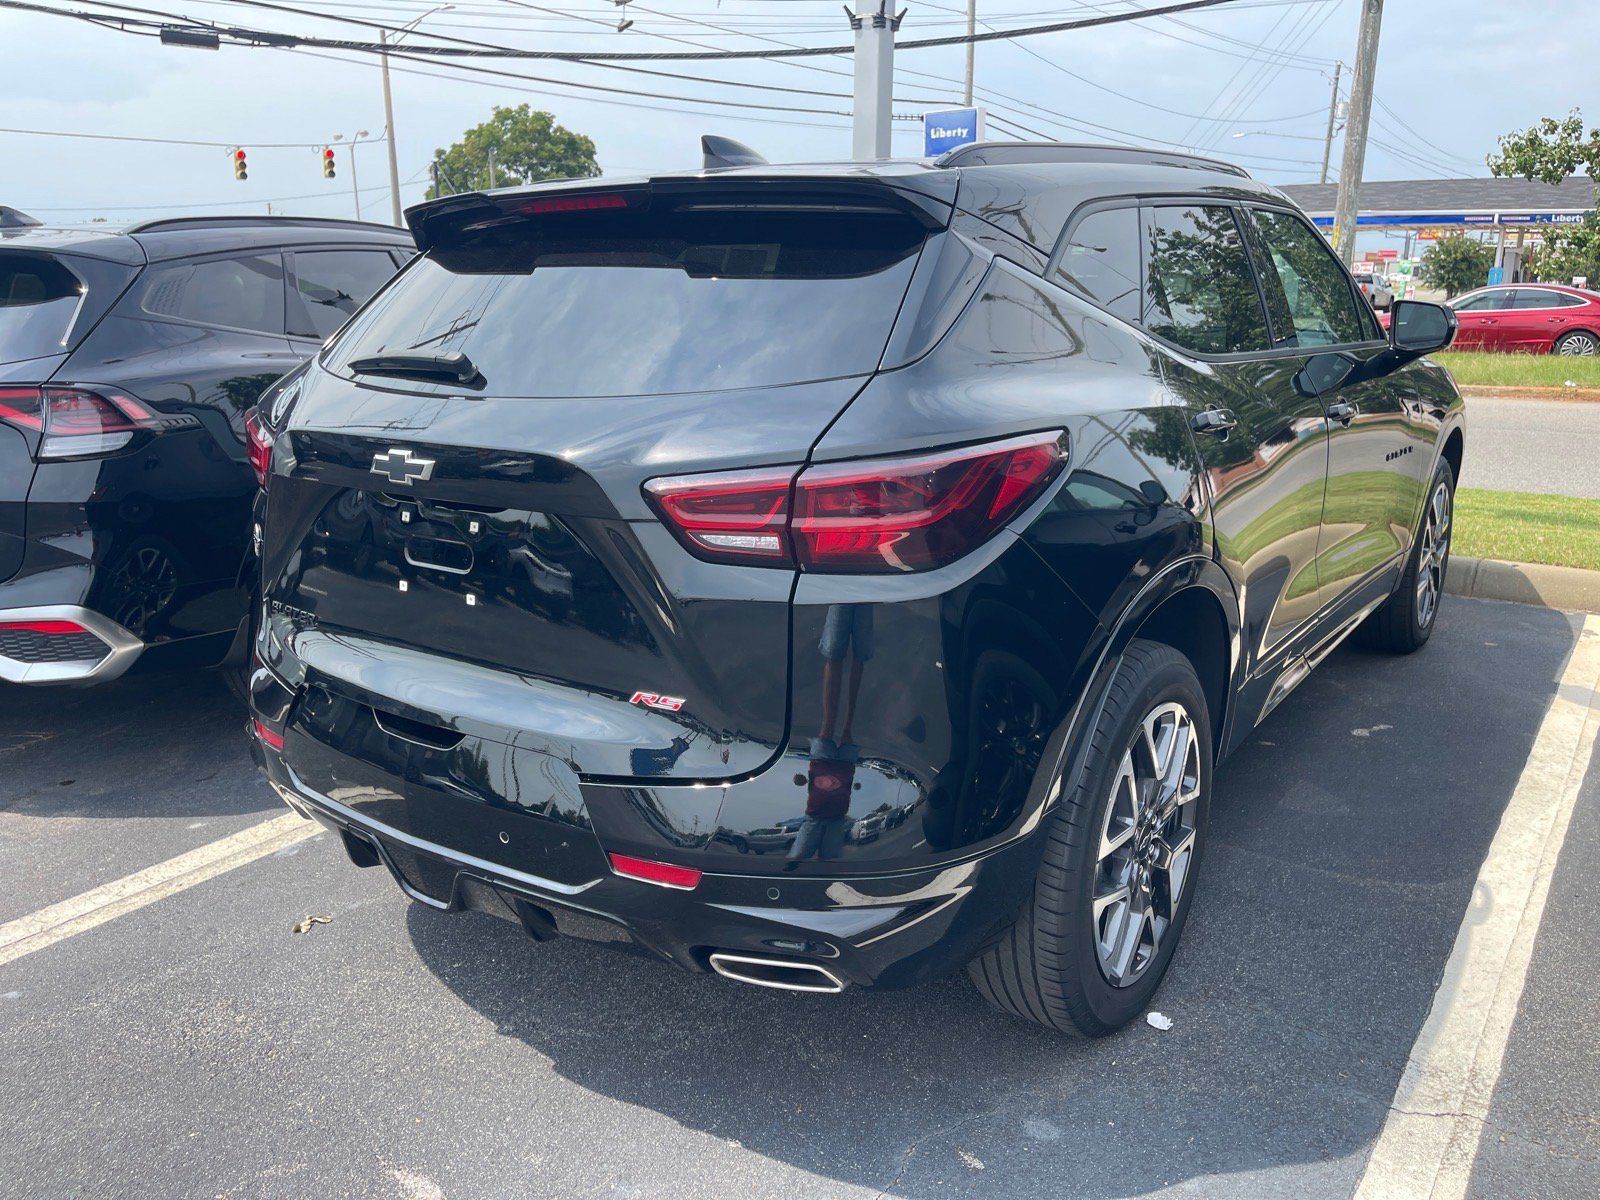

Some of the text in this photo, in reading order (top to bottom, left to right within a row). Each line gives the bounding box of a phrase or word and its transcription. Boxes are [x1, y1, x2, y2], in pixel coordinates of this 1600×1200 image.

[930, 127, 968, 139] Liberty
[1551, 214, 1584, 224] Liberty
[628, 691, 687, 712] RS
